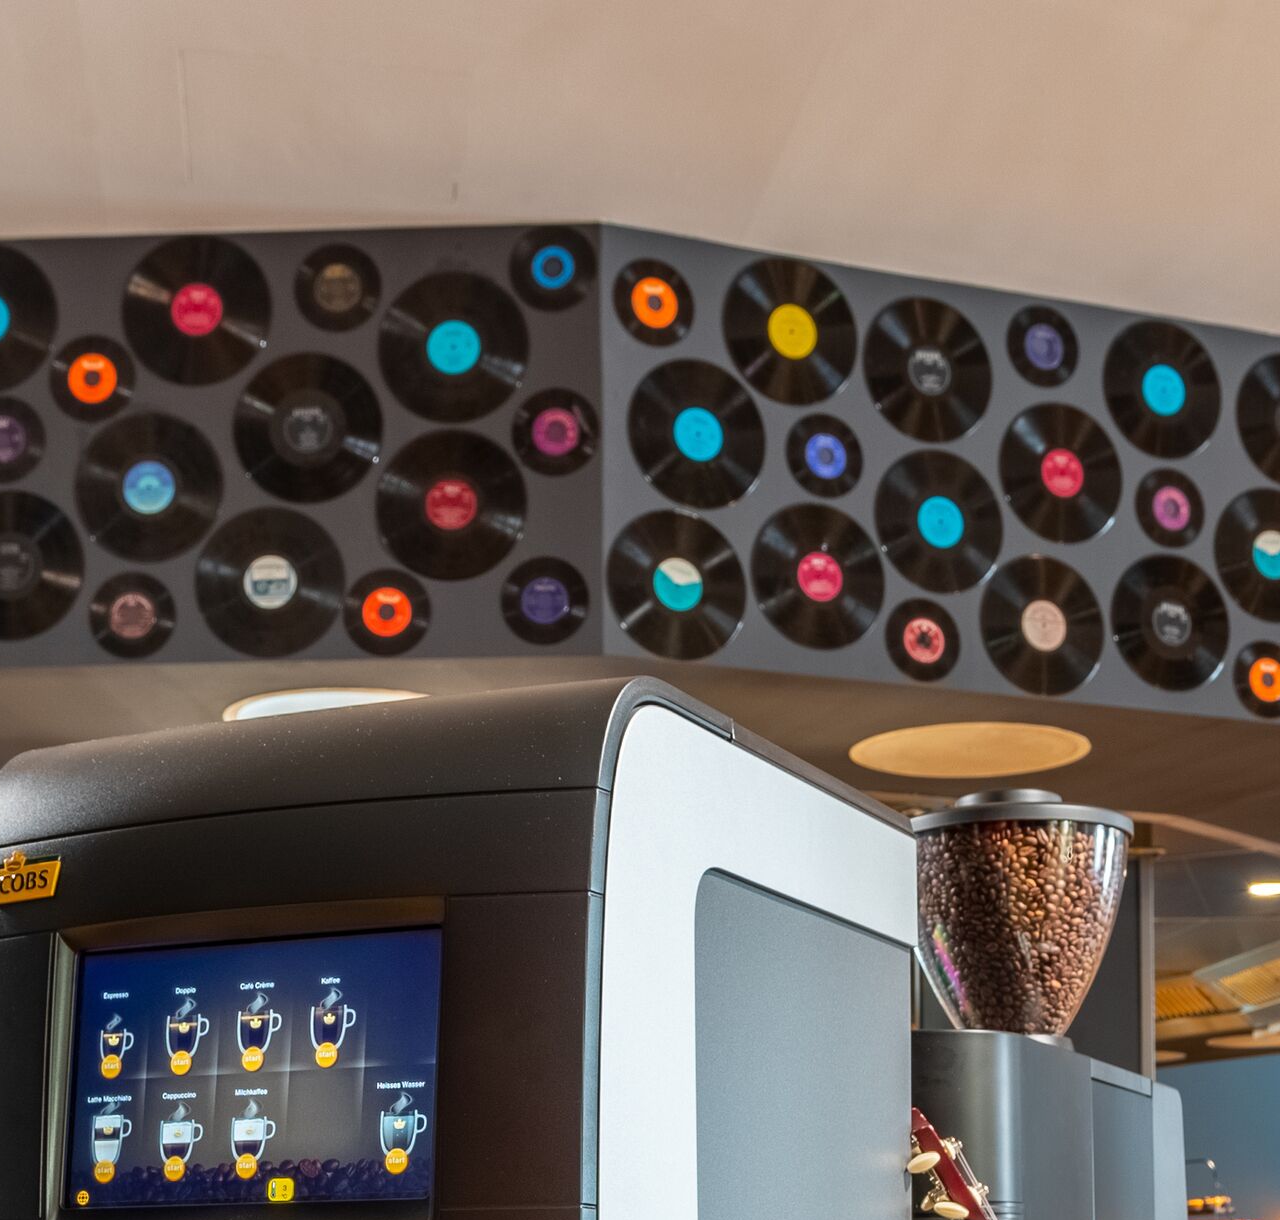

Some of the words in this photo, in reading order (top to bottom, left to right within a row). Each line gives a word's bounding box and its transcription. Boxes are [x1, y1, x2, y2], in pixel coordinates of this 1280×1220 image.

[321, 977, 341, 985] Kaffee
[175, 987, 196, 995] Doppio
[103, 992, 129, 1000] Espresso
[376, 1082, 401, 1090] Heisses
[162, 1092, 197, 1100] Cappuccino
[234, 1088, 268, 1096] Milchkaffee
